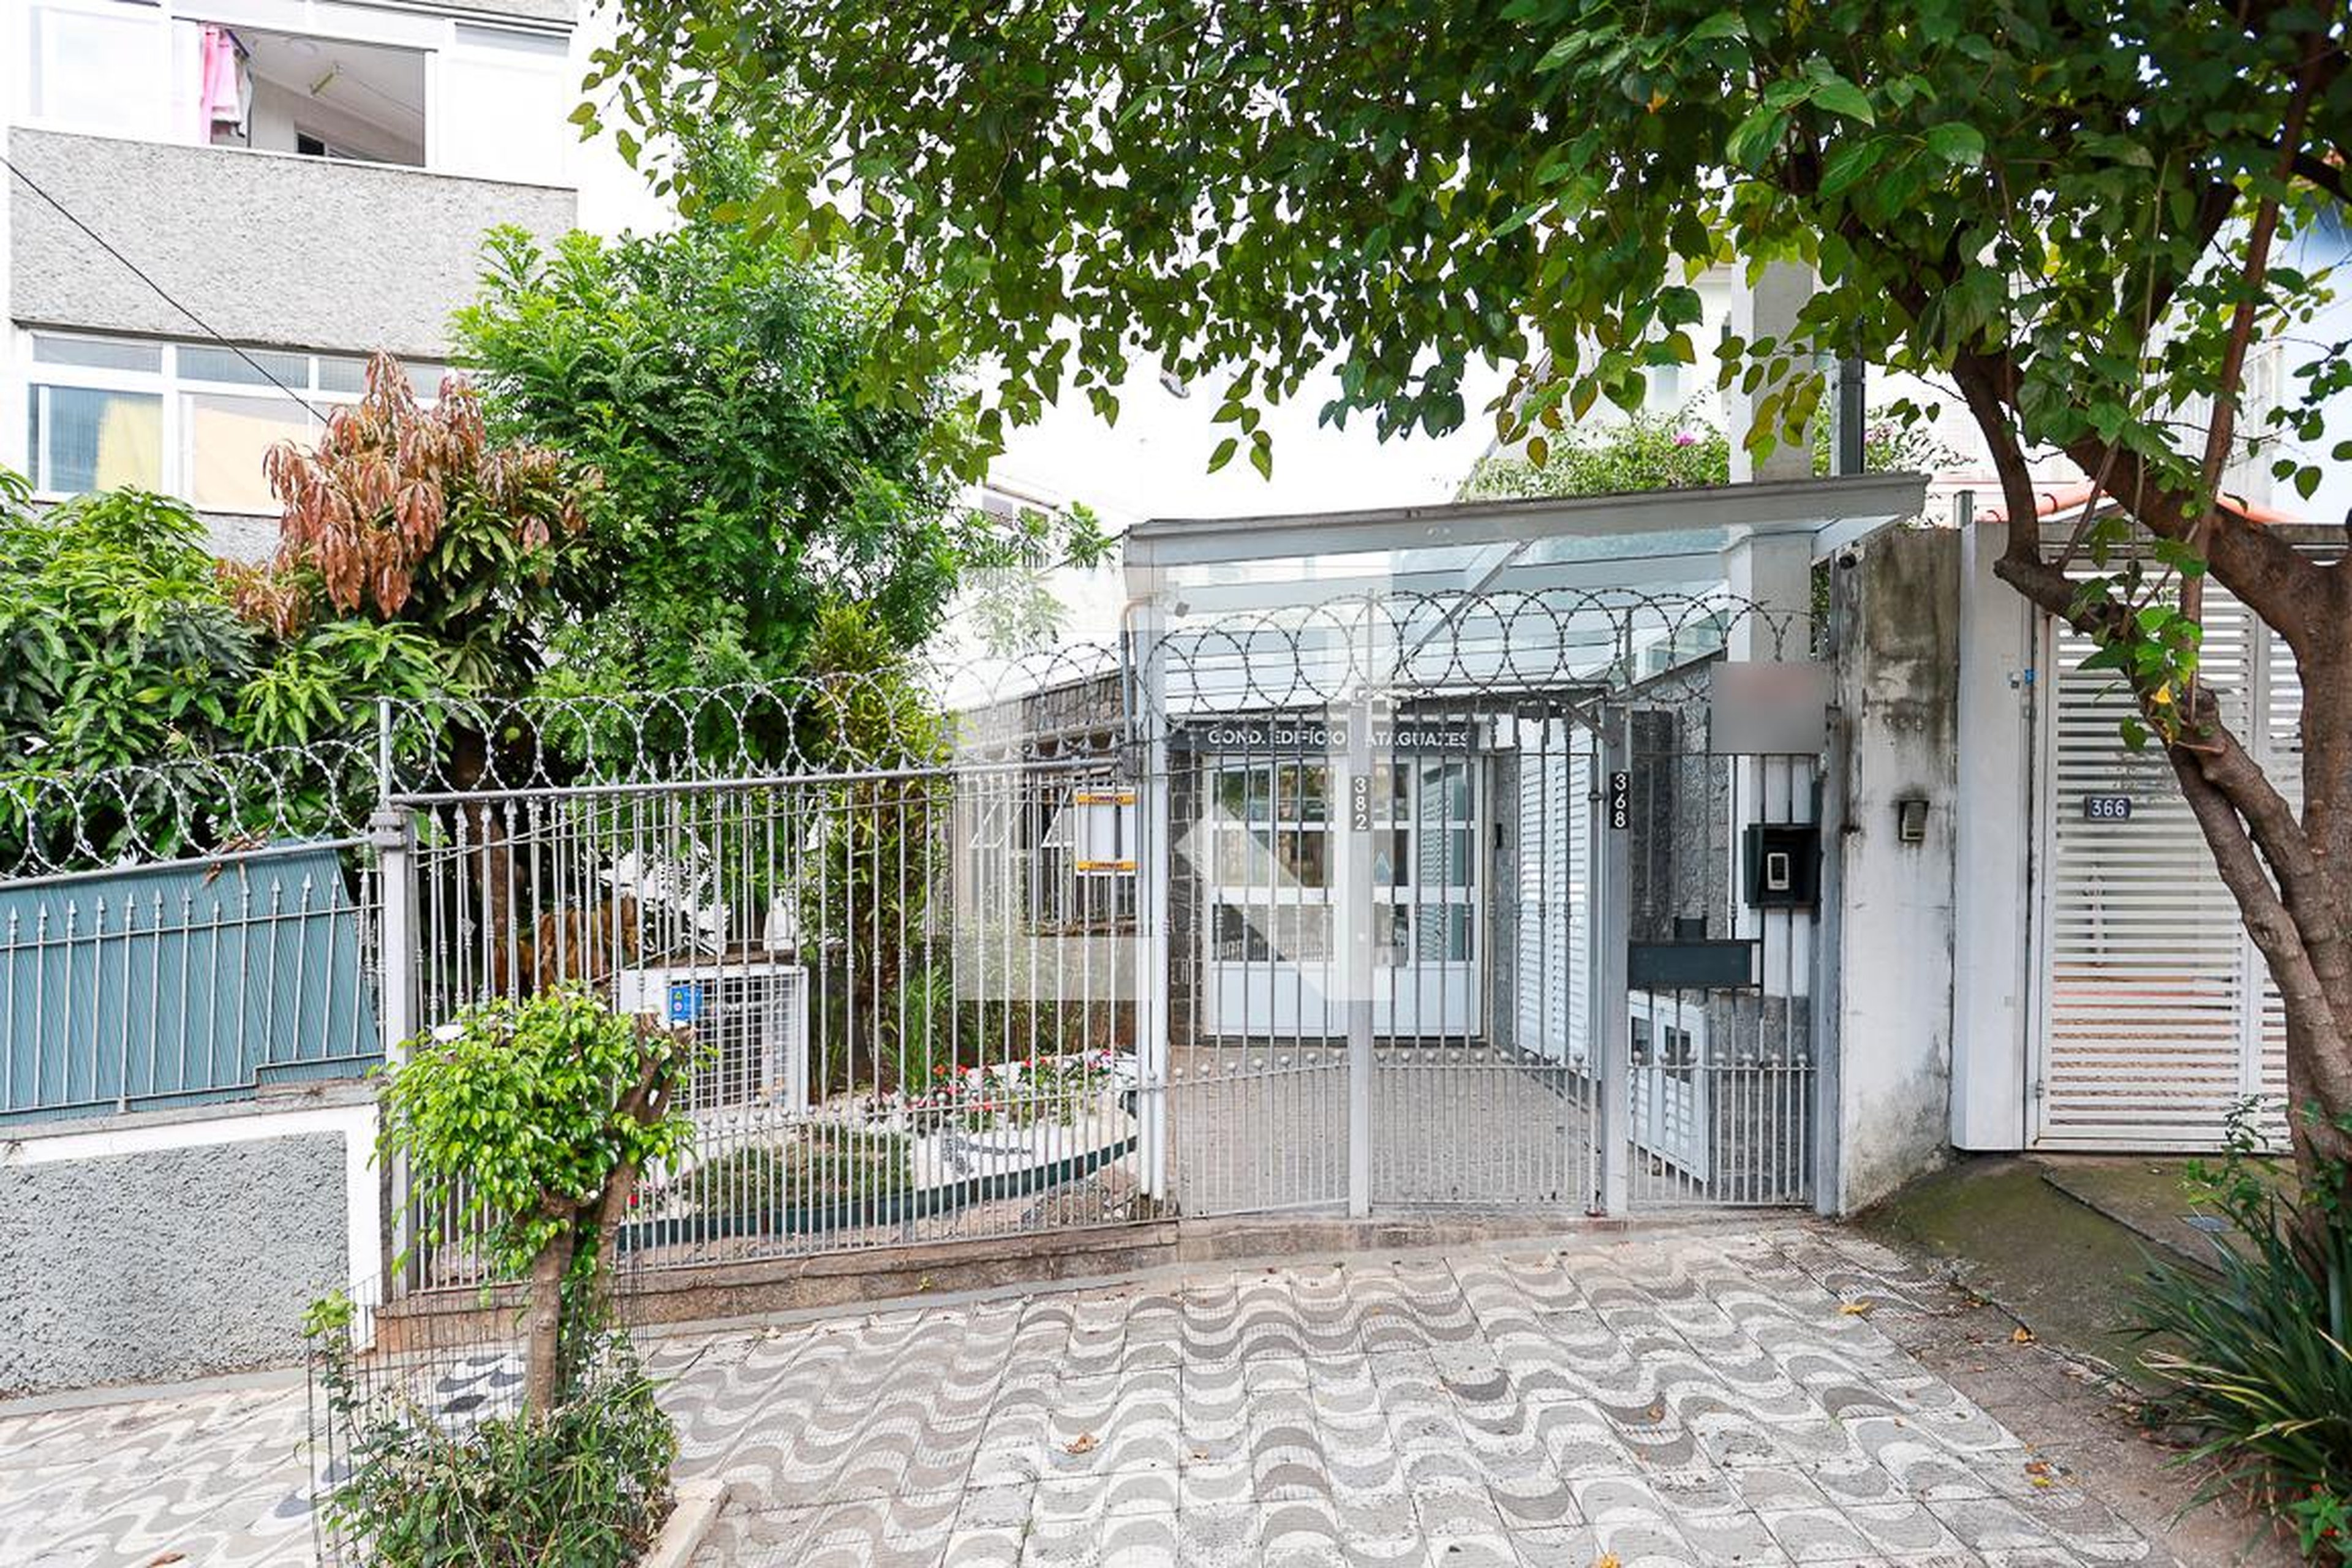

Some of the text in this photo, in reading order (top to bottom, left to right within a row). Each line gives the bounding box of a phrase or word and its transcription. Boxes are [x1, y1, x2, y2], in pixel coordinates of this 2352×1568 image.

[1208, 729, 1265, 744] COND.
[1274, 726, 1346, 745] EDIFÍCIO
[1355, 777, 1366, 830] 382
[1615, 774, 1626, 828] 368
[2092, 800, 2124, 816] 366
